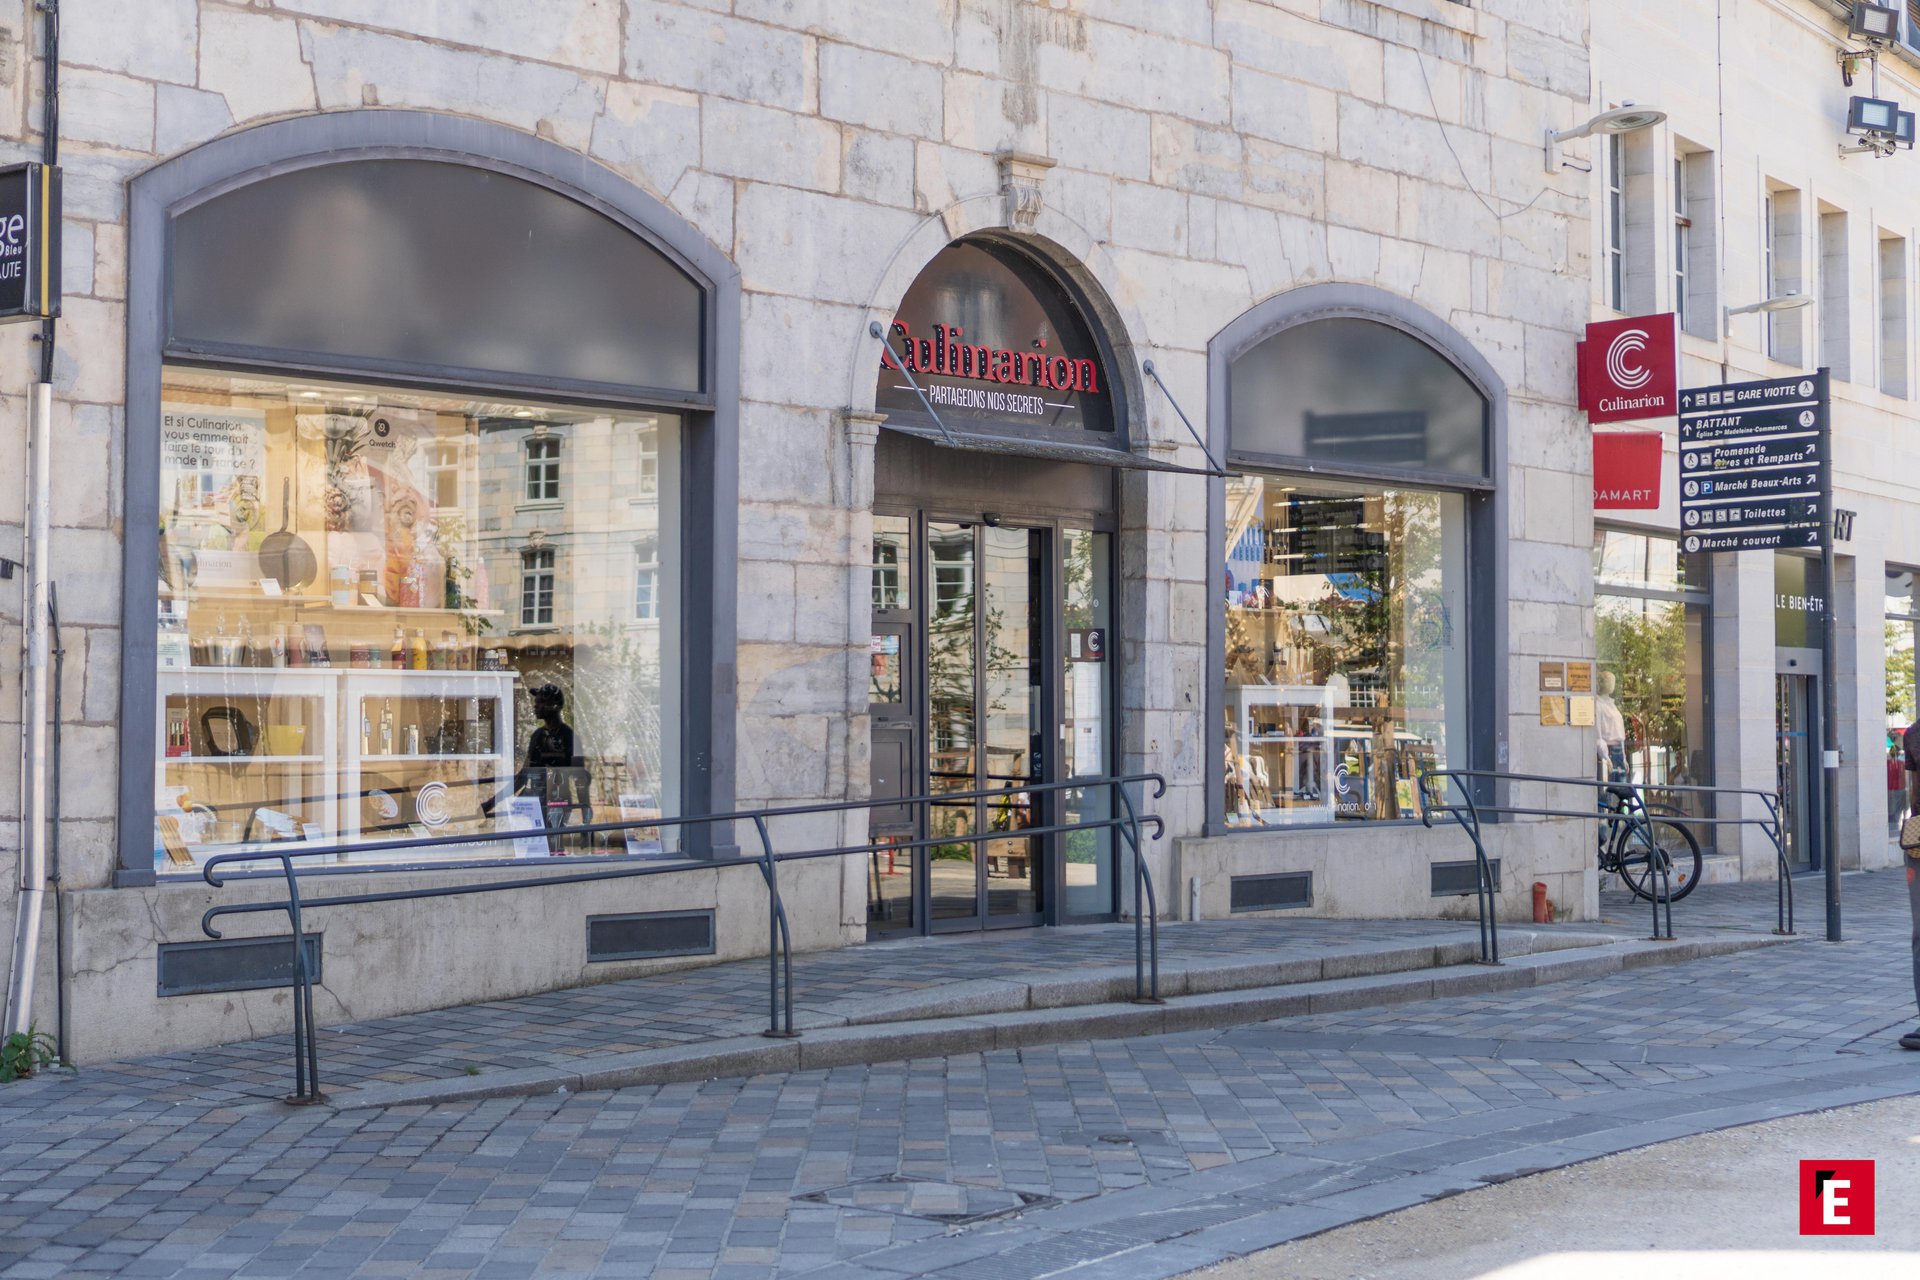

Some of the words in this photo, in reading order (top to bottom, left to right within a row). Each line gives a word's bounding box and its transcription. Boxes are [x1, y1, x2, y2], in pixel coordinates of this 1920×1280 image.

[5, 244, 23, 256] Bleu
[882, 320, 1099, 393] Culinarion
[929, 384, 986, 408] PARTAGEONS
[987, 392, 1005, 411] NOS
[1007, 393, 1044, 415] SECRETS
[1737, 389, 1761, 400] GARE
[1764, 385, 1796, 398] VIOTTE
[1599, 394, 1665, 412] Culinarion
[164, 415, 173, 427] Et
[176, 417, 184, 427] si
[187, 417, 242, 431] Culinarion
[1696, 416, 1742, 429] BATTANT
[164, 431, 190, 440] vous
[1714, 444, 1767, 458] Promenade
[164, 455, 197, 466] made
[1744, 456, 1754, 466] et
[1757, 452, 1804, 465] Remparts
[1714, 479, 1748, 492] Marché
[1751, 476, 1802, 489] Beaux-Arts
[1744, 508, 1786, 519] Toilettes
[1702, 537, 1738, 549] Marché
[1743, 535, 1781, 546] couvert
[1776, 594, 1786, 608] LE
